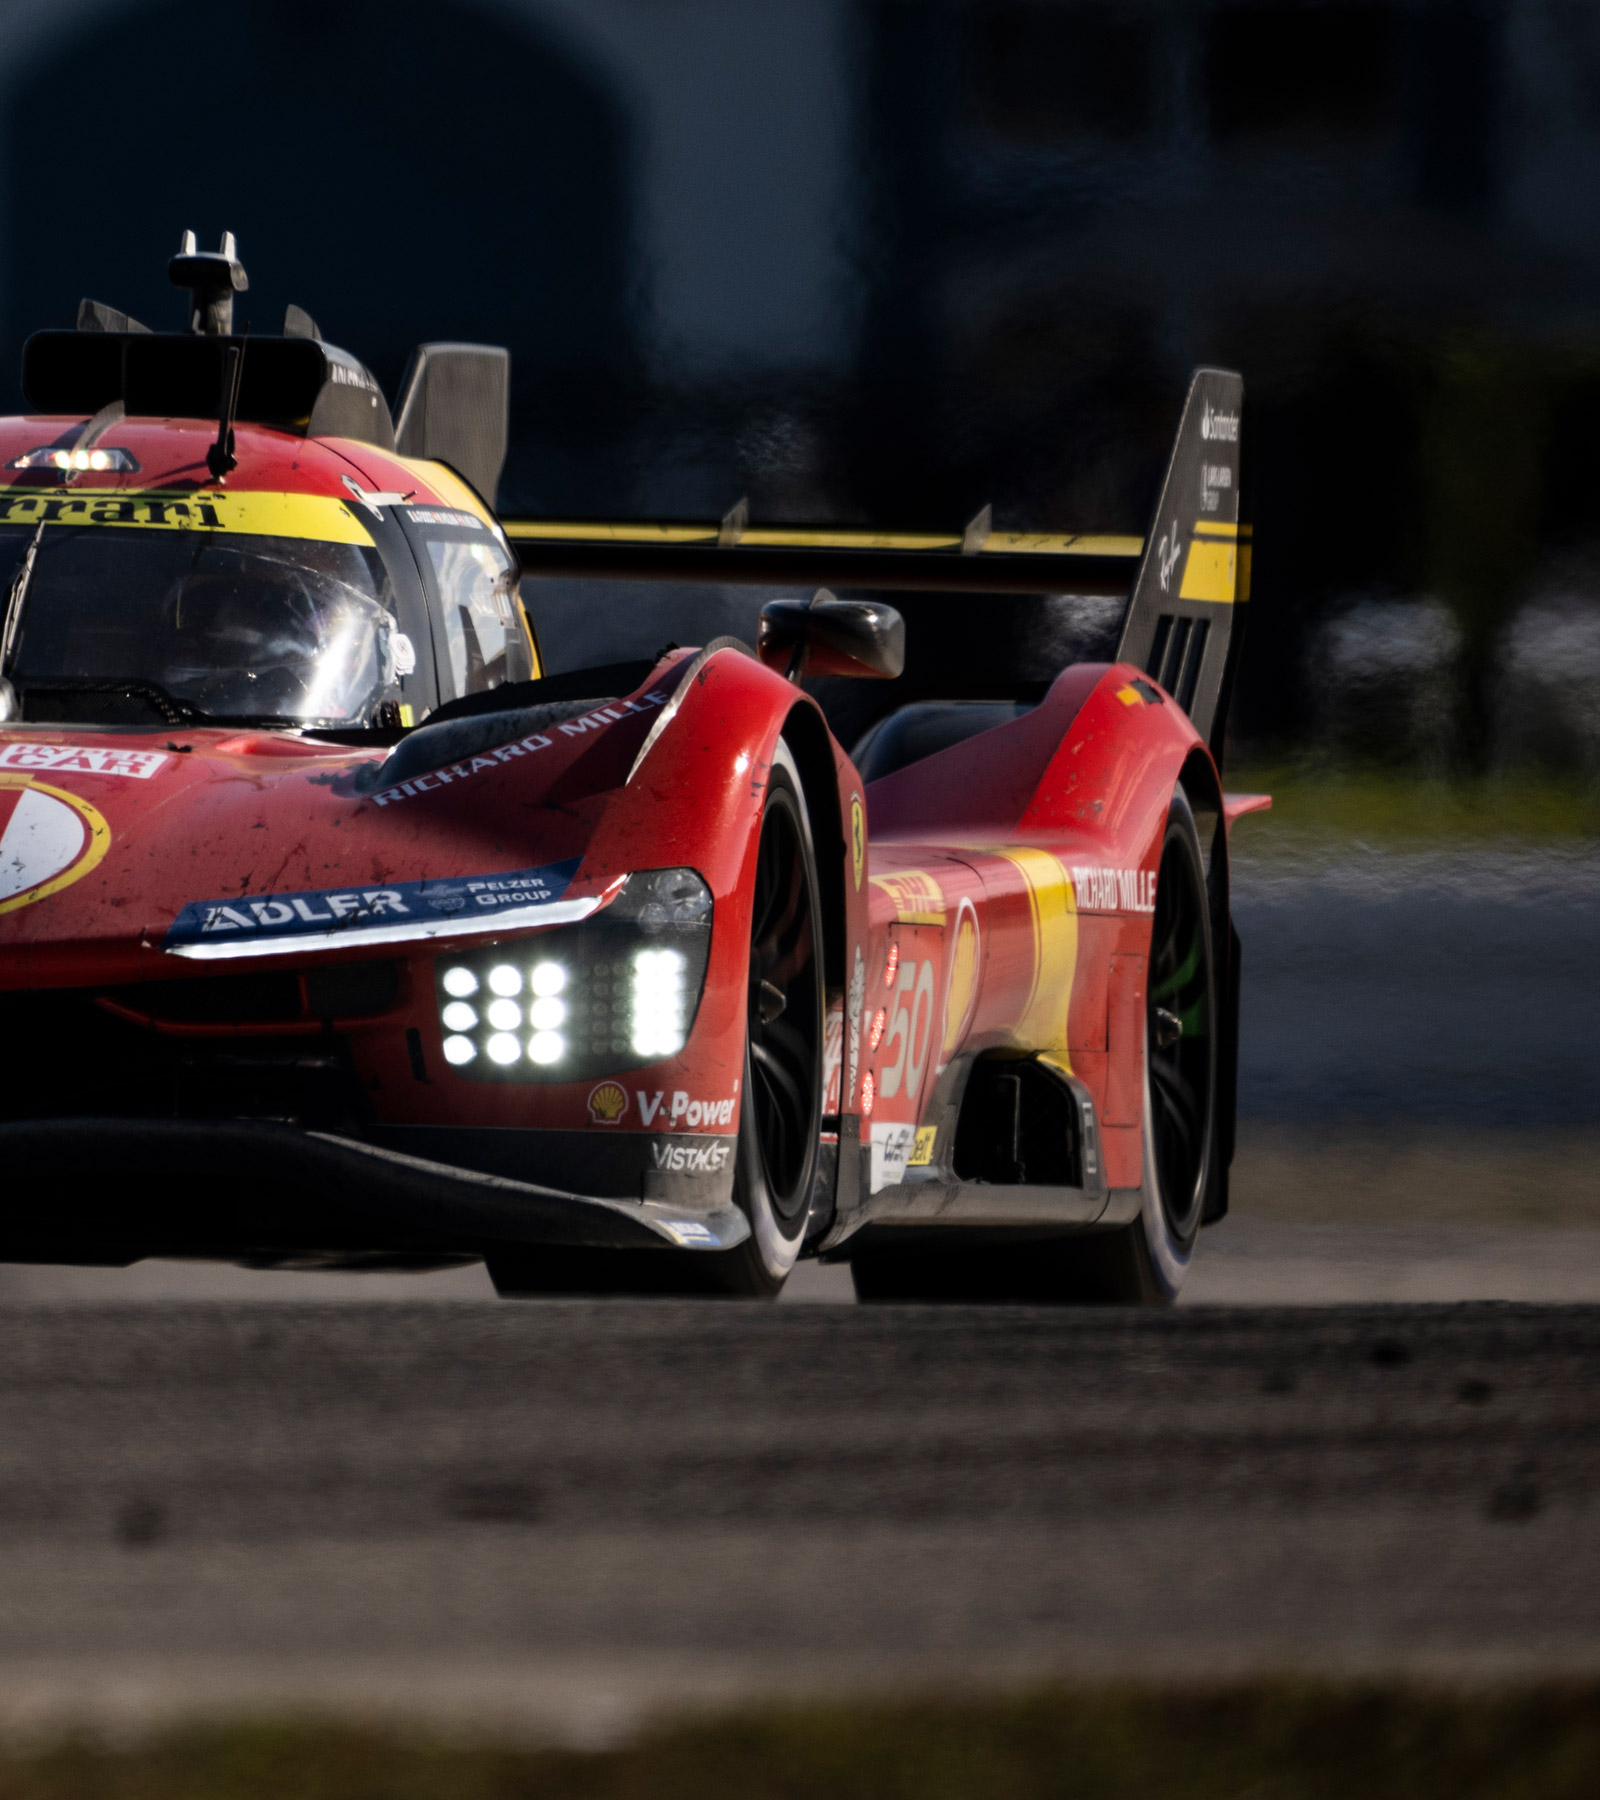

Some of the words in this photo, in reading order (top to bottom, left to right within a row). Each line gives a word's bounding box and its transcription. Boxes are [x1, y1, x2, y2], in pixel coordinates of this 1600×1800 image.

[16, 745, 154, 762] HYPER
[371, 733, 553, 806] RICHARD
[558, 690, 673, 737] MILLE
[6, 754, 146, 775] CAR
[467, 878, 545, 893] PELZER
[475, 889, 551, 905] GROUP
[1118, 869, 1156, 912] MILLE
[202, 890, 410, 932] ADLER
[879, 959, 934, 1100] 50
